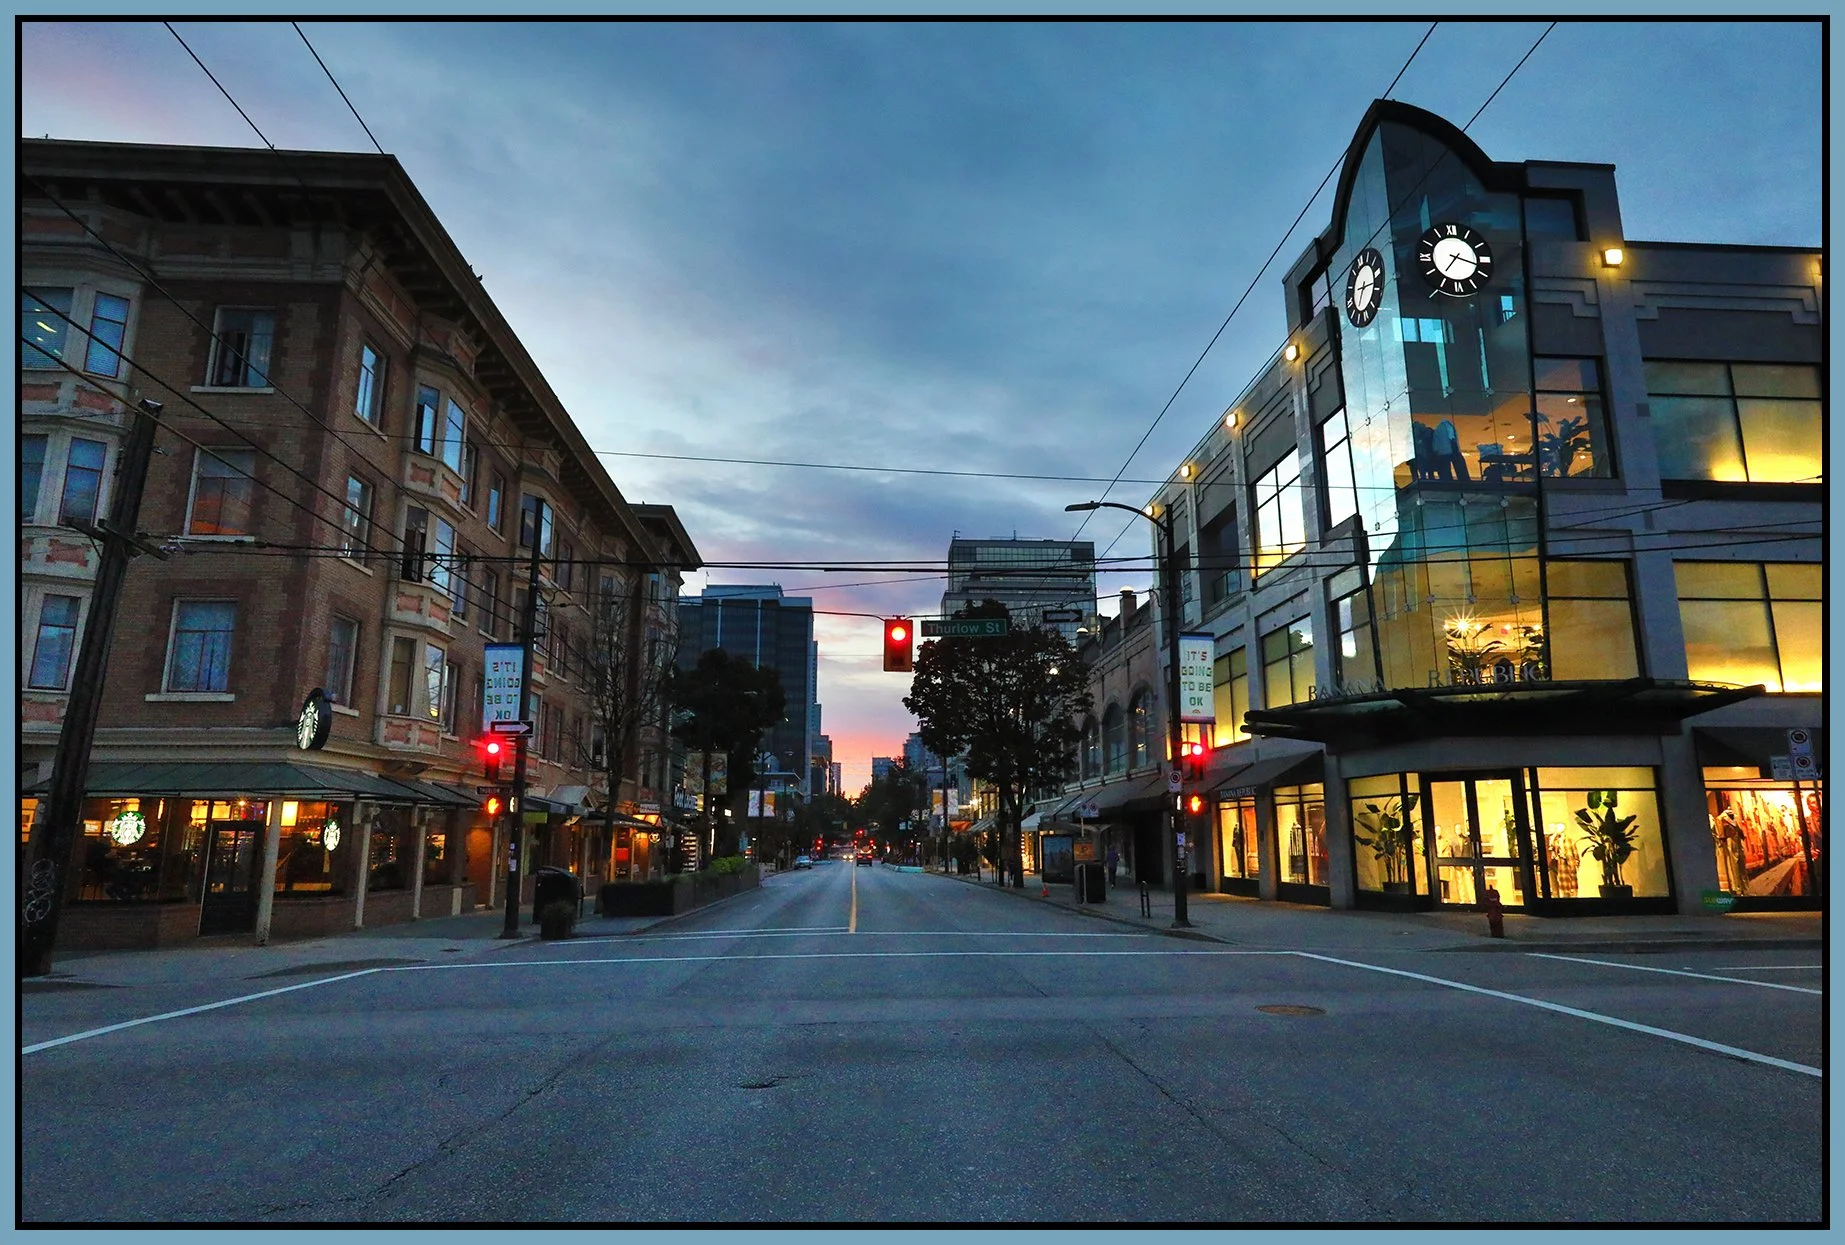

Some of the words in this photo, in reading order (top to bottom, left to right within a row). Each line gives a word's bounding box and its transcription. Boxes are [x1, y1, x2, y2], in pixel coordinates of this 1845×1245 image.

[928, 622, 979, 634] Thurlow
[986, 622, 1000, 633] St
[1187, 650, 1207, 661] IT'S
[1182, 666, 1212, 677] GOING
[1182, 681, 1195, 691] TO
[1199, 682, 1211, 692] BE
[1190, 697, 1203, 706] OK
